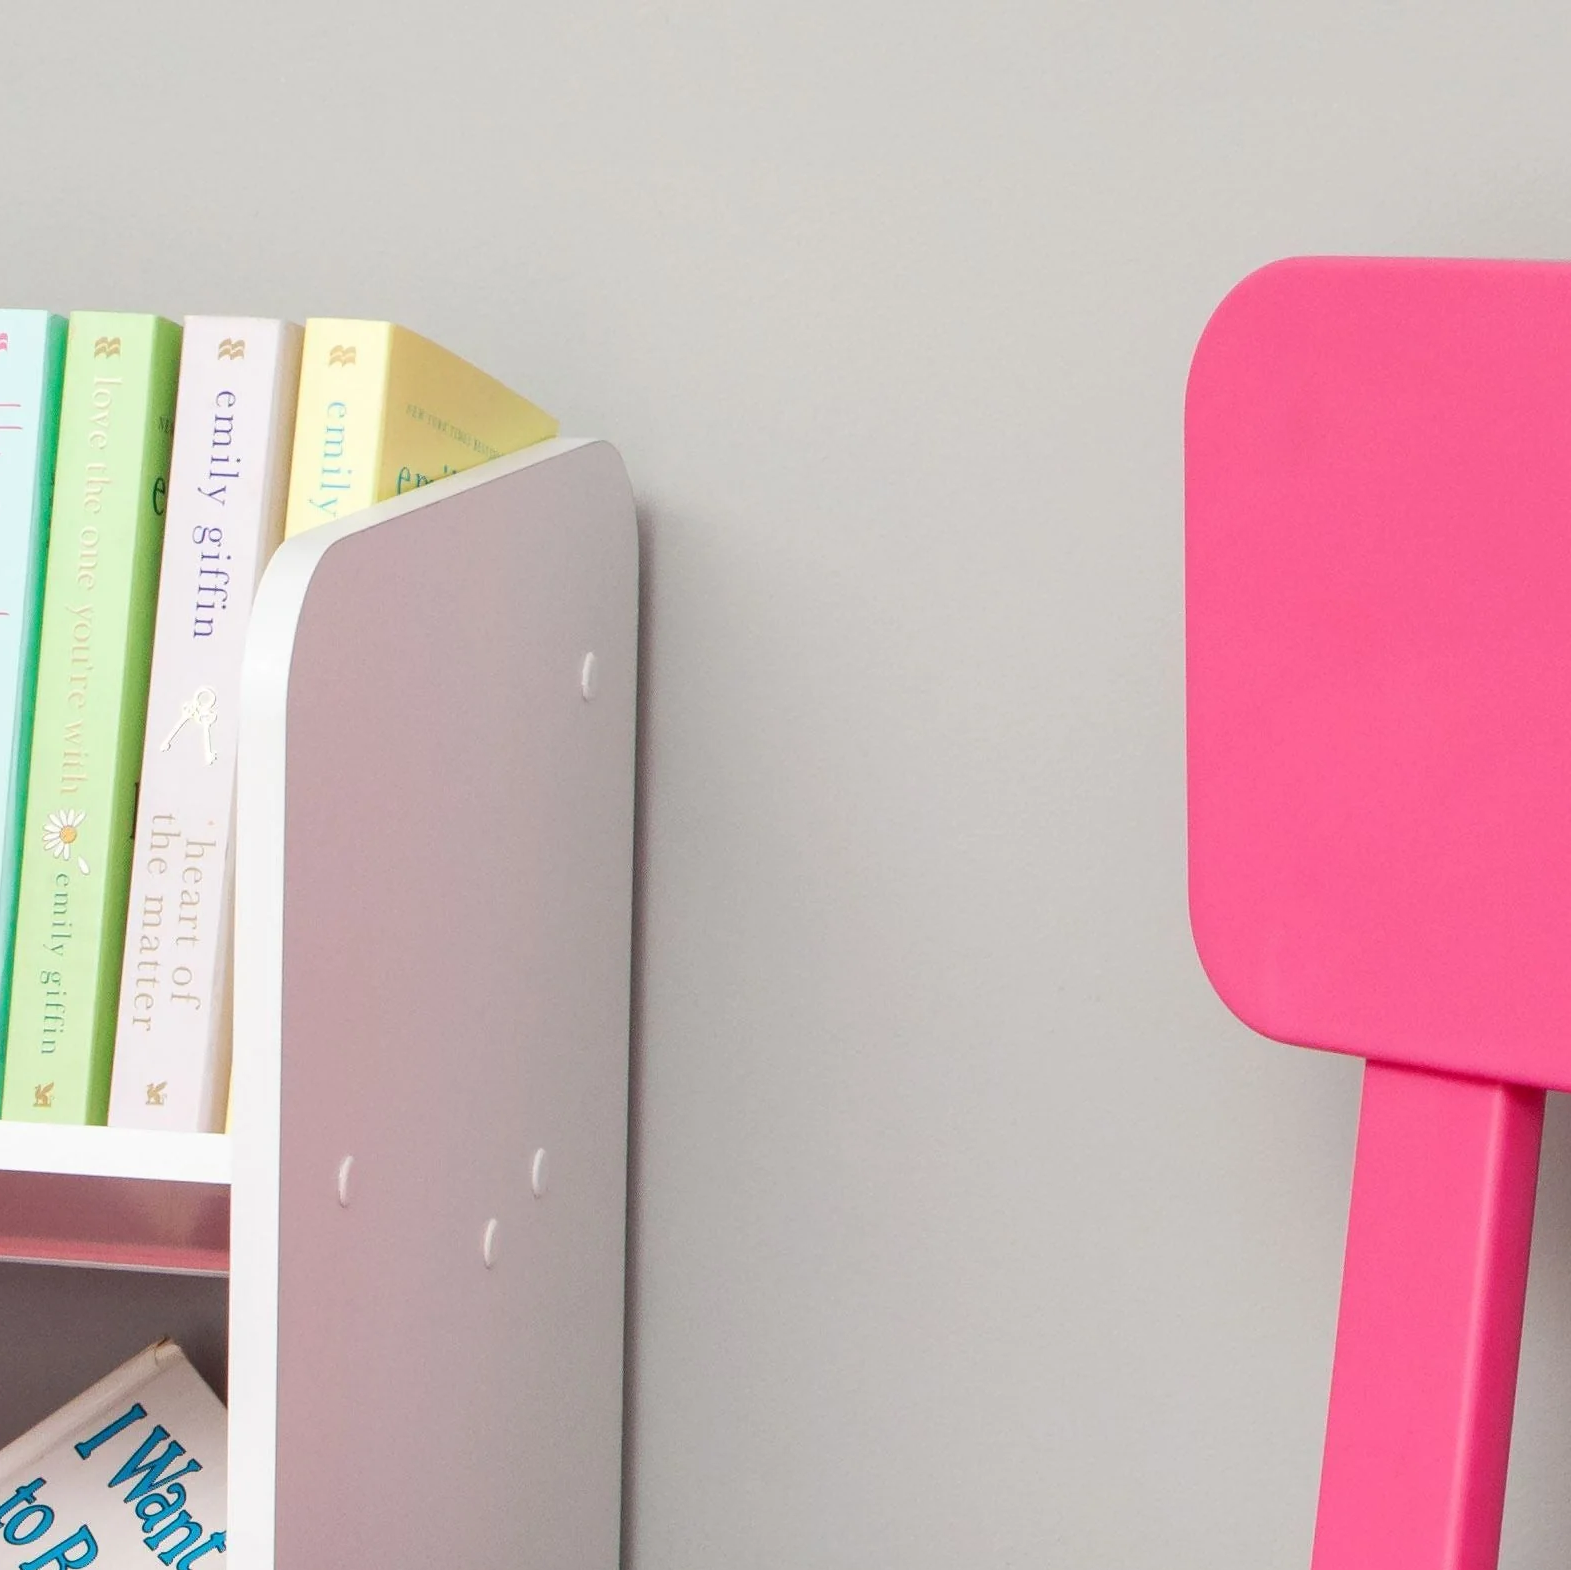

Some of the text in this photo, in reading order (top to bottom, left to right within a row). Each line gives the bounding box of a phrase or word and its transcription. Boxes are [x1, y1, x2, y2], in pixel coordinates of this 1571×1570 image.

[192, 390, 242, 639] emily giffin
[308, 401, 352, 518] emily
[59, 375, 124, 795] love the one you're with
[40, 873, 72, 1055] emily giffin
[132, 813, 182, 1032] the matter
[170, 839, 217, 1010] heart of
[72, 1402, 148, 1461] I
